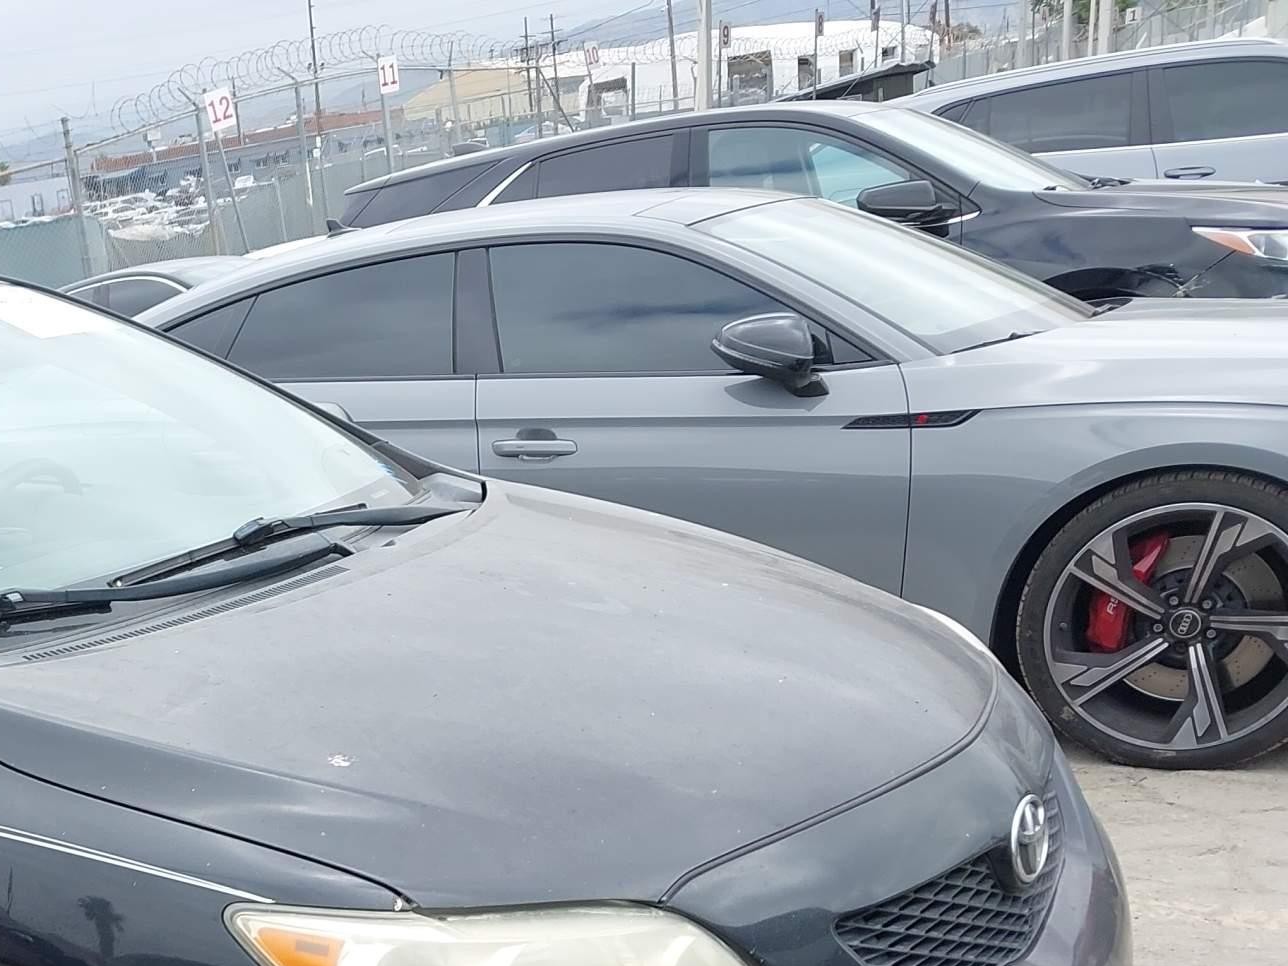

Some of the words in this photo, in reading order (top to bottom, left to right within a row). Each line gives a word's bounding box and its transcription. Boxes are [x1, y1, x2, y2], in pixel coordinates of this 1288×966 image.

[818, 14, 824, 34] 8
[722, 25, 729, 45] 9
[586, 46, 599, 65] 10
[380, 63, 398, 87] 11
[208, 96, 233, 124] 12
